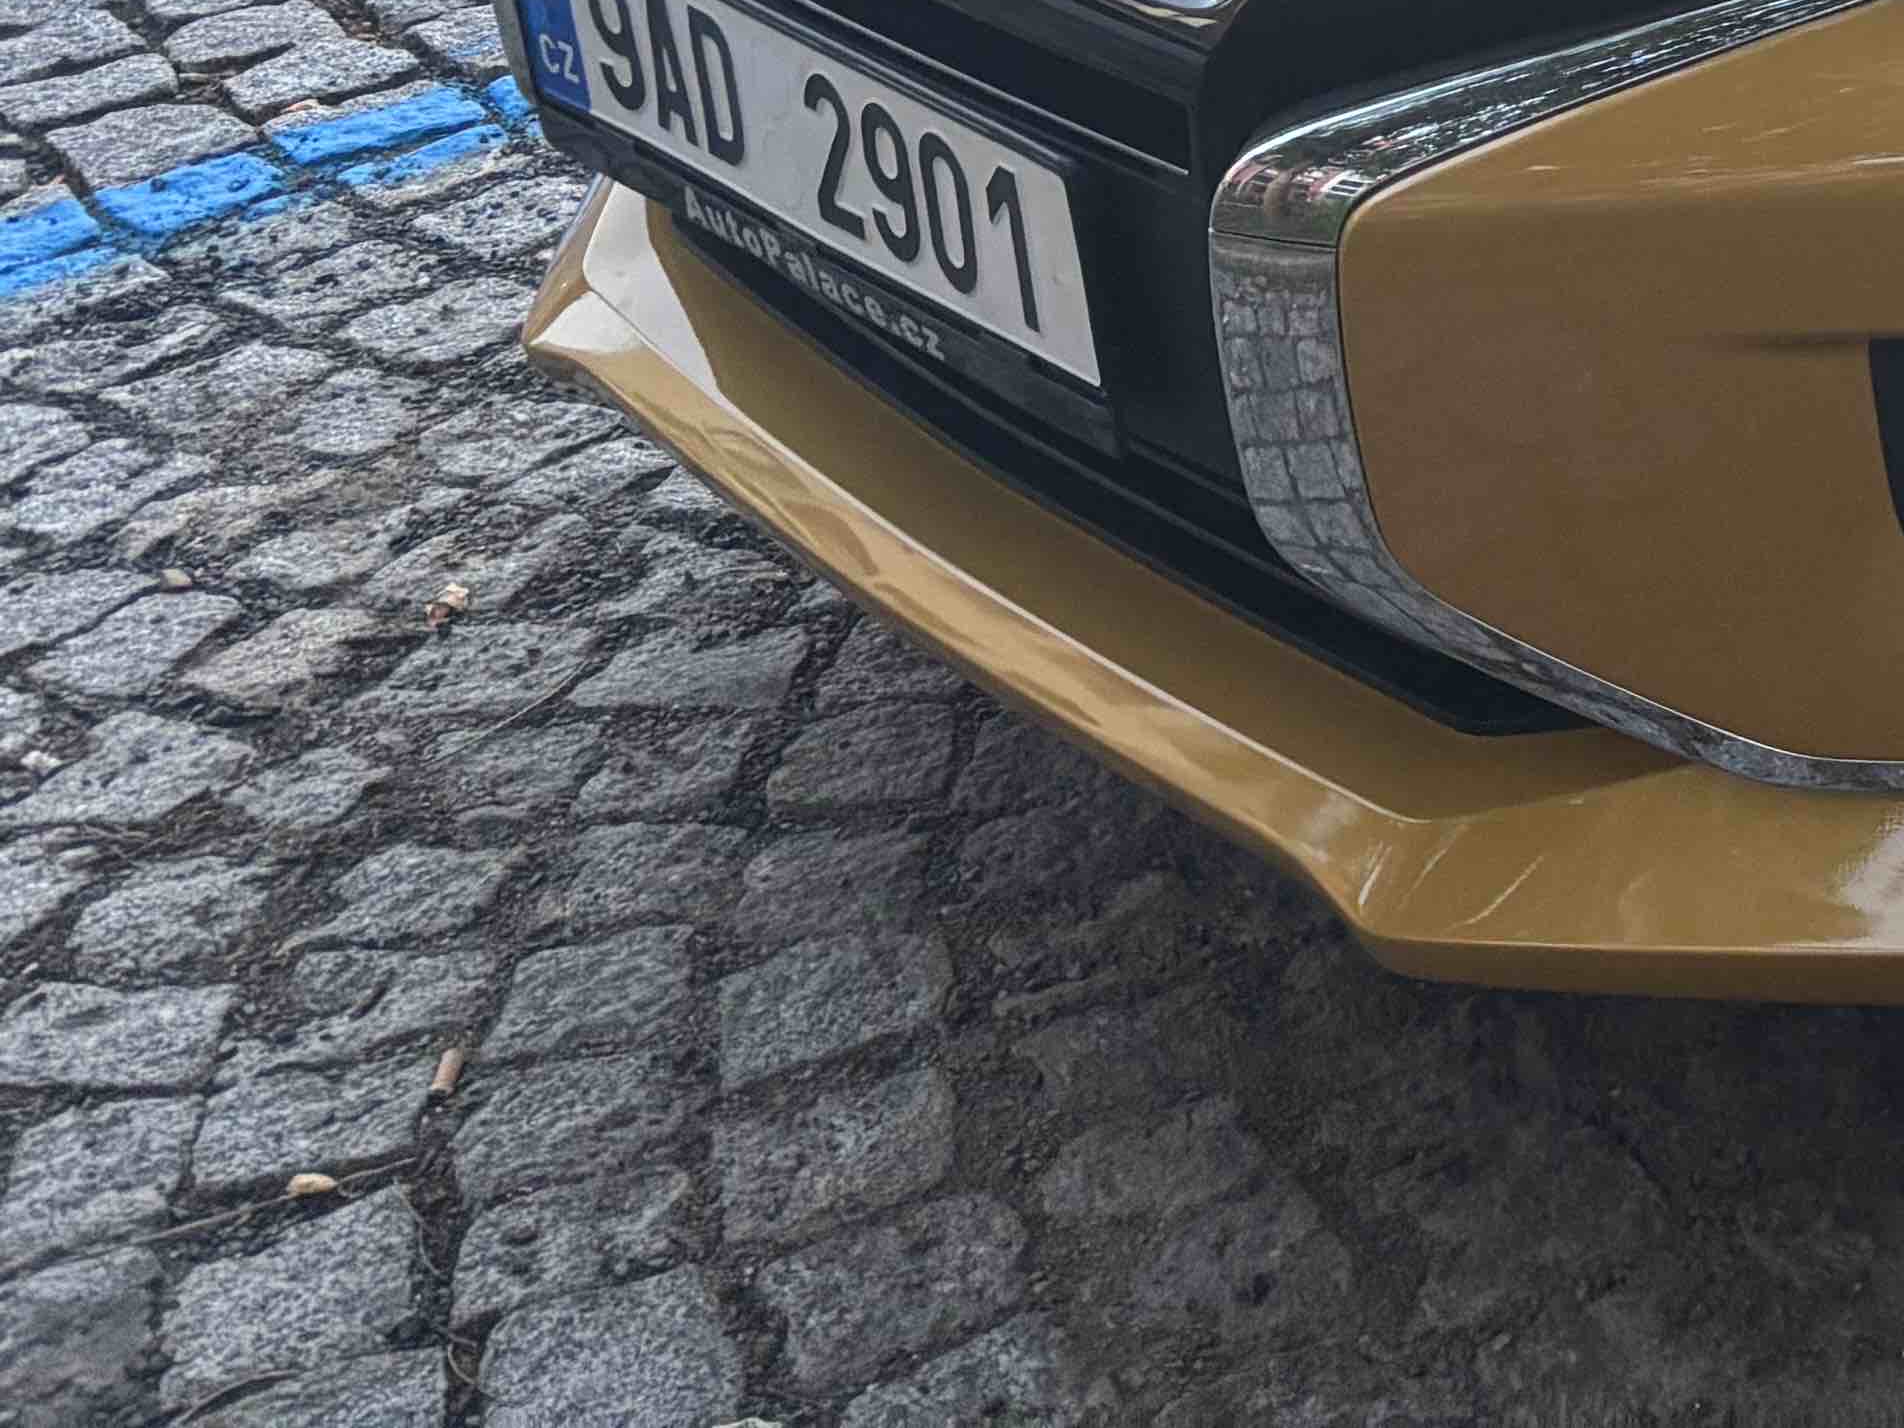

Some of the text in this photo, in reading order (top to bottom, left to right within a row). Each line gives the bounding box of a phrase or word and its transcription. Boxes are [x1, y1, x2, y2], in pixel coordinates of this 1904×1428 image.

[539, 33, 581, 84] CZ
[803, 72, 1041, 334] 2901
[683, 185, 946, 360] AutoPalace.cz
